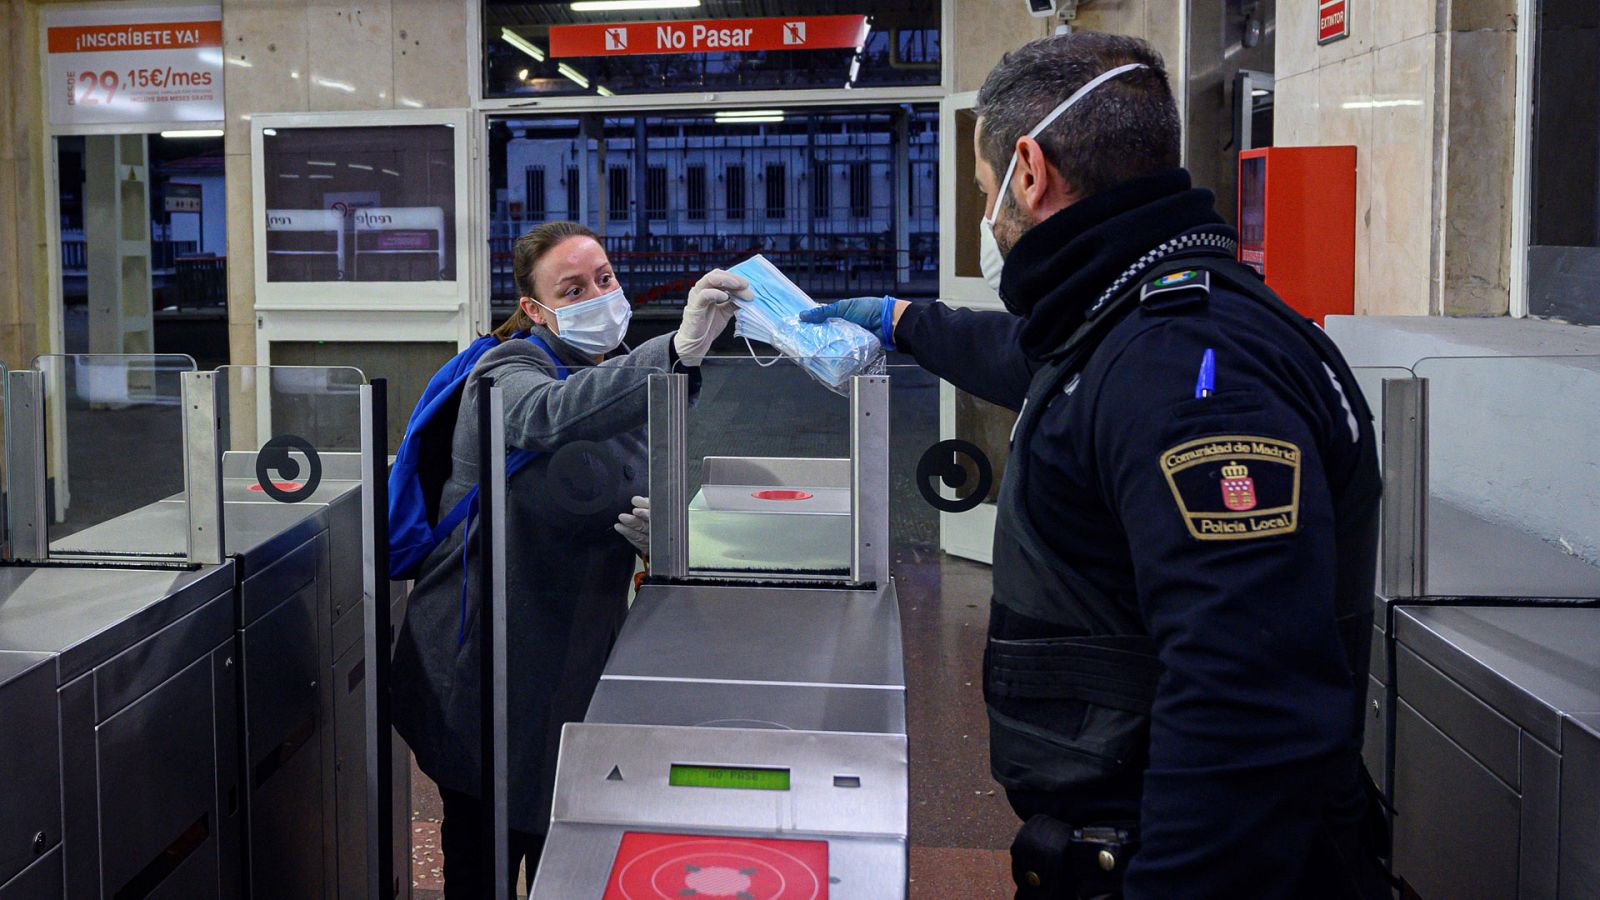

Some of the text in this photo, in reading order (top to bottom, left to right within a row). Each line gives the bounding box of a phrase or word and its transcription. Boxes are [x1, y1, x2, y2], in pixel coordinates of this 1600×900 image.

[76, 28, 199, 50] ¡INSCRÍBETE YA!
[656, 24, 753, 49] No Pasar
[1167, 442, 1296, 467] Comunidad de Madrid
[1249, 514, 1290, 531] Local
